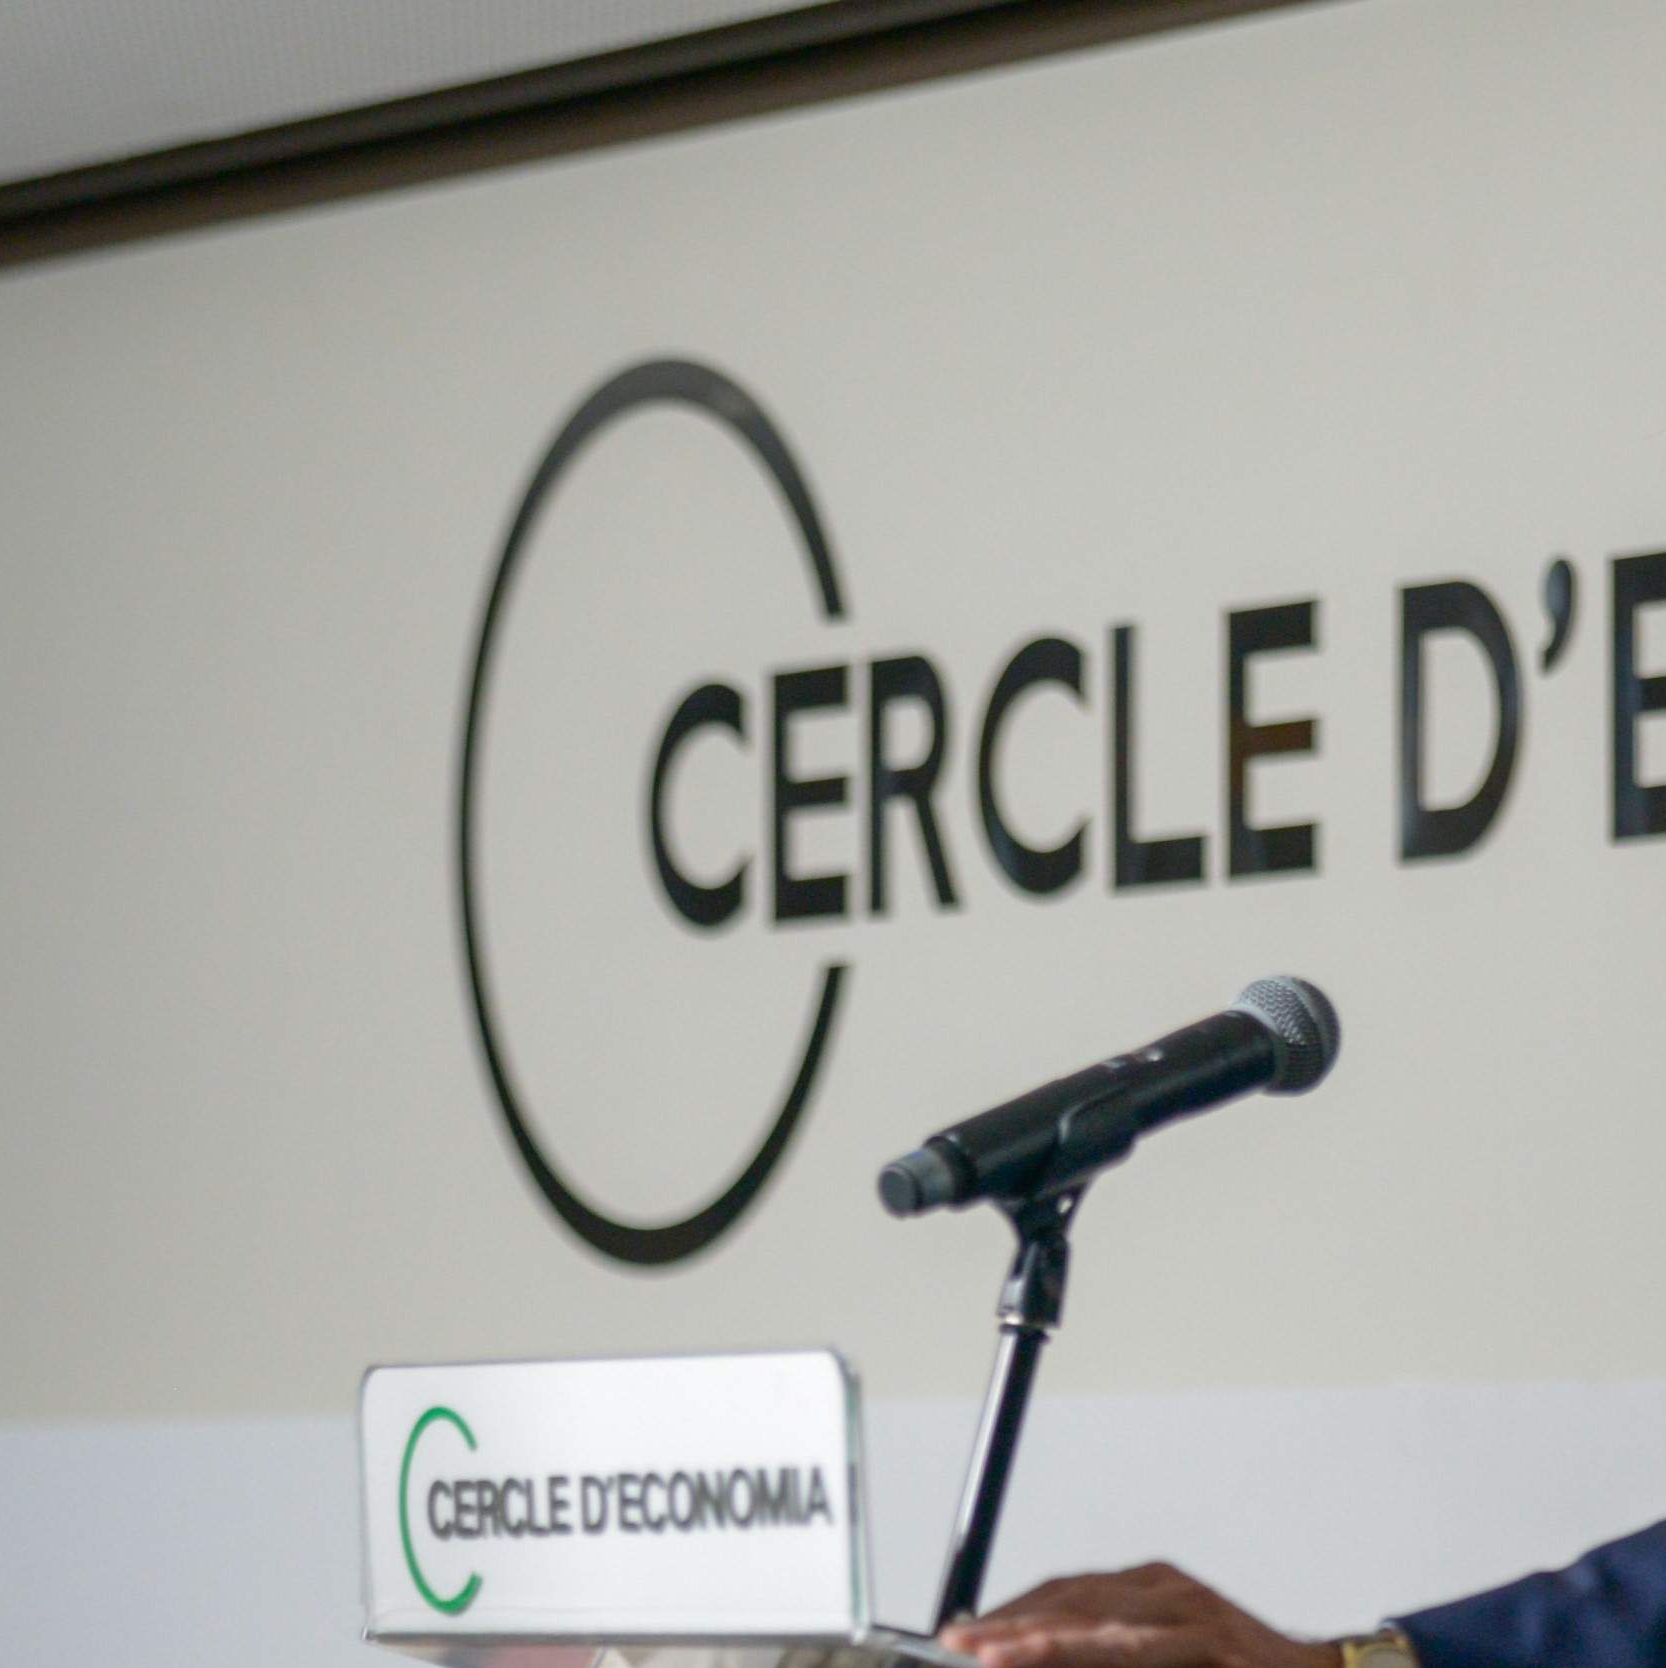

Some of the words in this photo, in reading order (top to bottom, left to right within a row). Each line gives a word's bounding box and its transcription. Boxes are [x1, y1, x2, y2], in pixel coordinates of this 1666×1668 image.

[645, 598, 1321, 933] CERCLE
[426, 1475, 572, 1541] CERCLE
[580, 1465, 833, 1536] D'ECONOMIA
